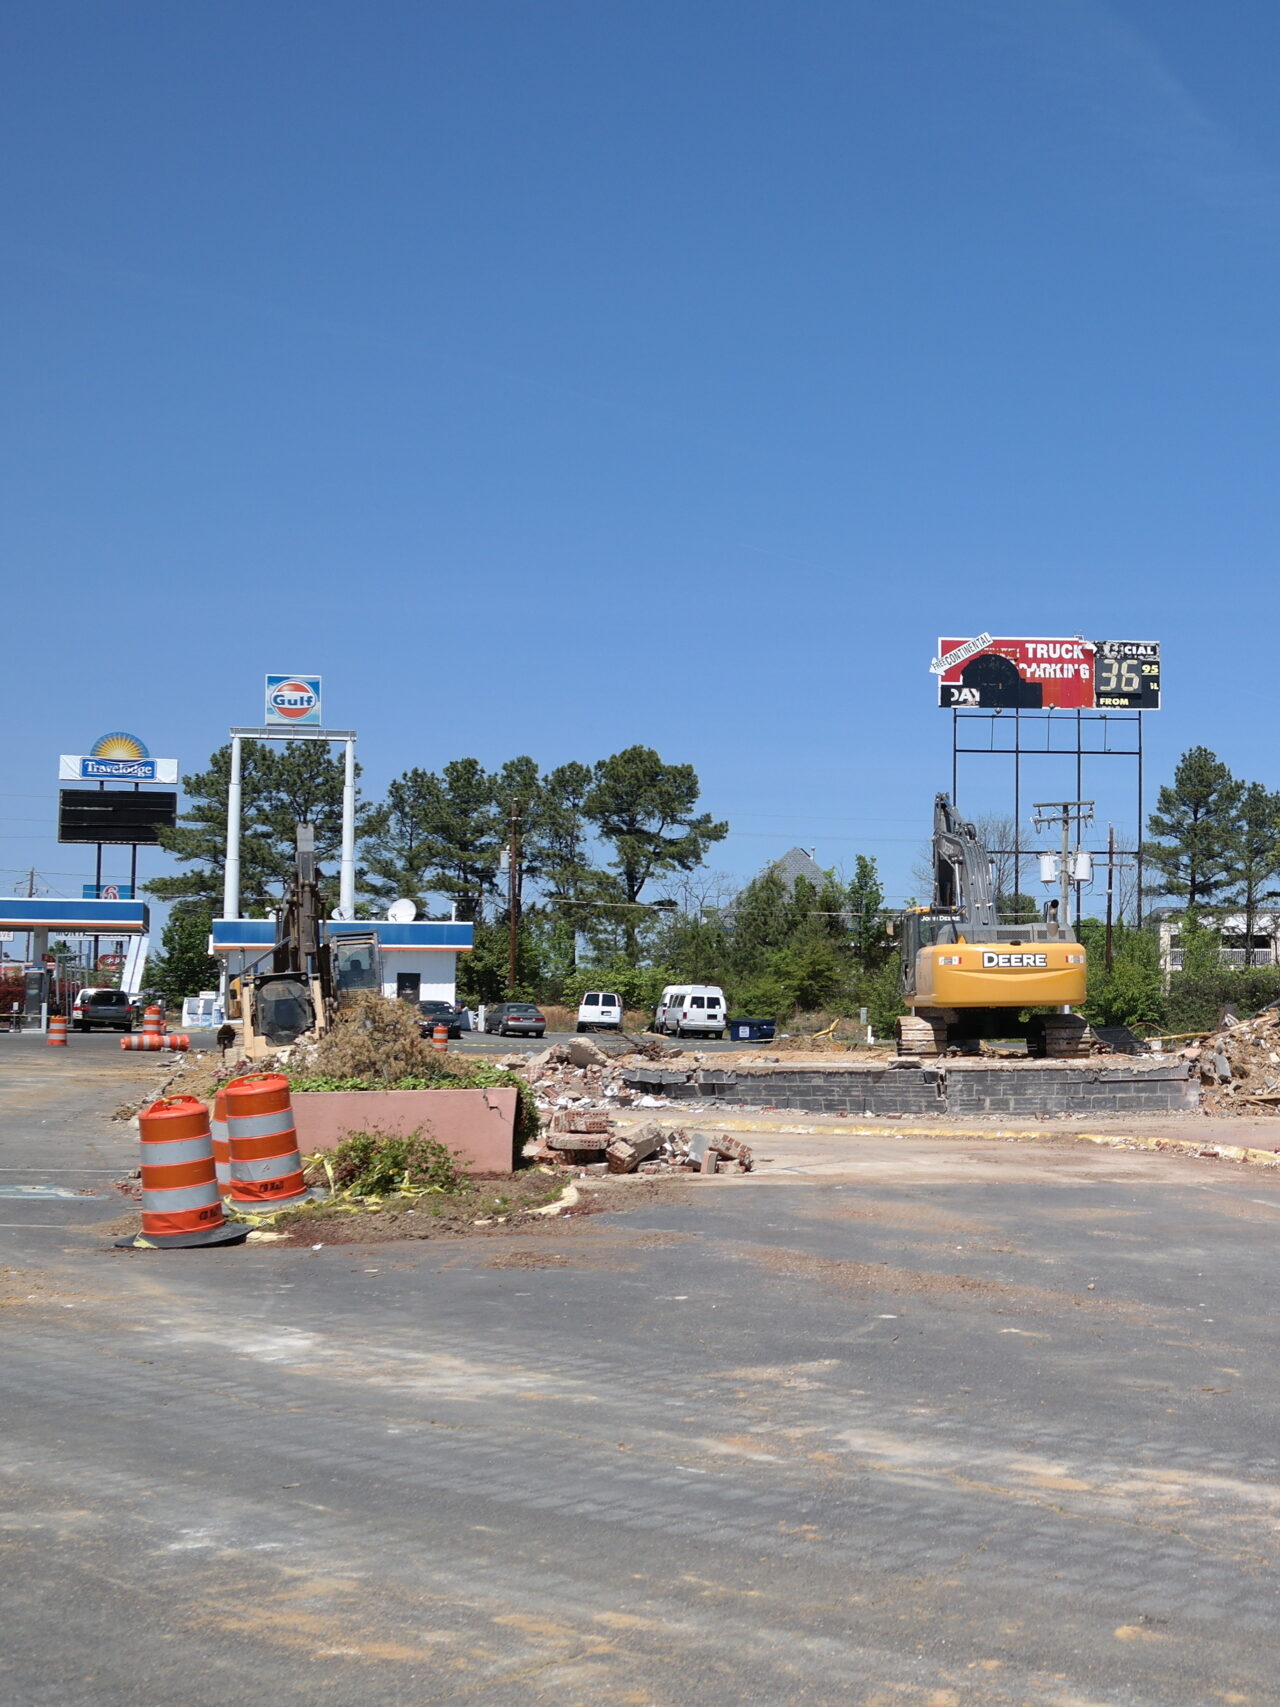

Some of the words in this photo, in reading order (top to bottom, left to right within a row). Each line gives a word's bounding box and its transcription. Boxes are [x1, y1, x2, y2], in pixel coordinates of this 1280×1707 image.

[945, 634, 992, 665] CONTINENTAL
[1025, 643, 1085, 658] TRUCK
[1100, 659, 1140, 691] 36
[1142, 664, 1160, 674] 95
[273, 694, 314, 706] Gulf
[1099, 697, 1129, 706] FROM
[85, 761, 153, 777] Travelodge
[983, 953, 1047, 967] DEERE
